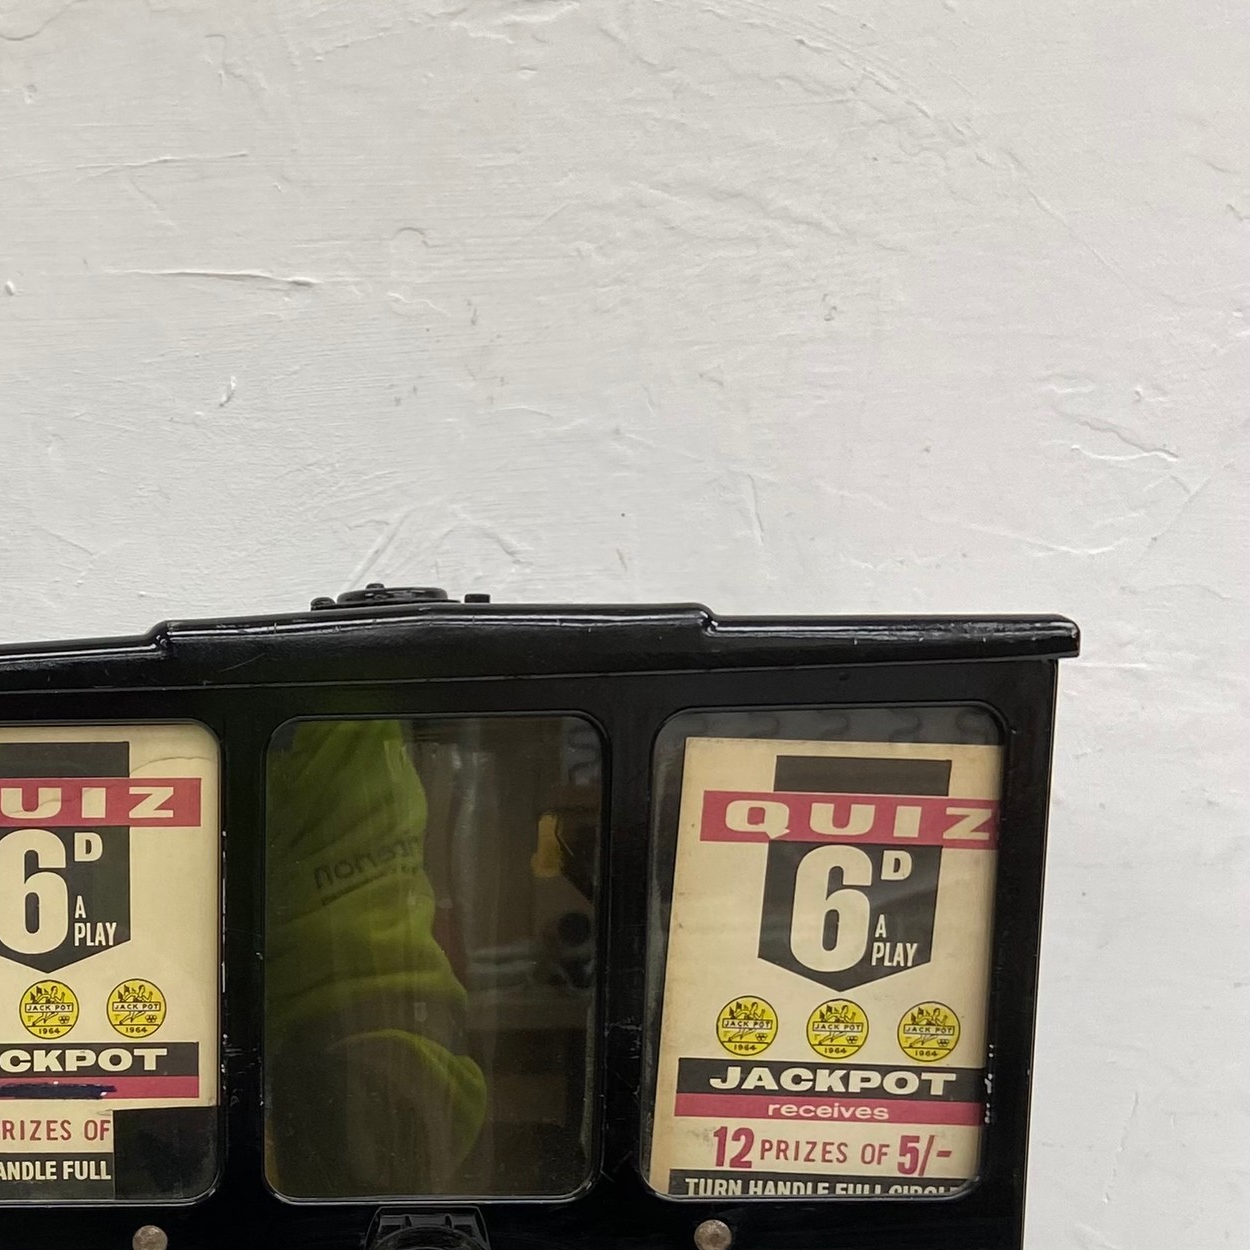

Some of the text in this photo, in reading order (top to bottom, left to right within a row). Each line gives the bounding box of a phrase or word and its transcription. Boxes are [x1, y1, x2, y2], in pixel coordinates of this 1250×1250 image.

[725, 799, 993, 841] QUIZ
[74, 894, 87, 920] A
[74, 922, 118, 947] PLAY
[874, 914, 888, 939] A
[871, 941, 918, 968] PLAY
[125, 1026, 148, 1034] 1964
[824, 1047, 847, 1055] 1964
[709, 1066, 956, 1096] JACKPOT
[767, 1102, 889, 1120] receives
[84, 1119, 112, 1141] OF
[713, 1126, 953, 1177] 12 PRIZES OF 5/-
[63, 1160, 112, 1181] FULL
[685, 1178, 742, 1196] TURN
[749, 1180, 830, 1195] HANDLE
